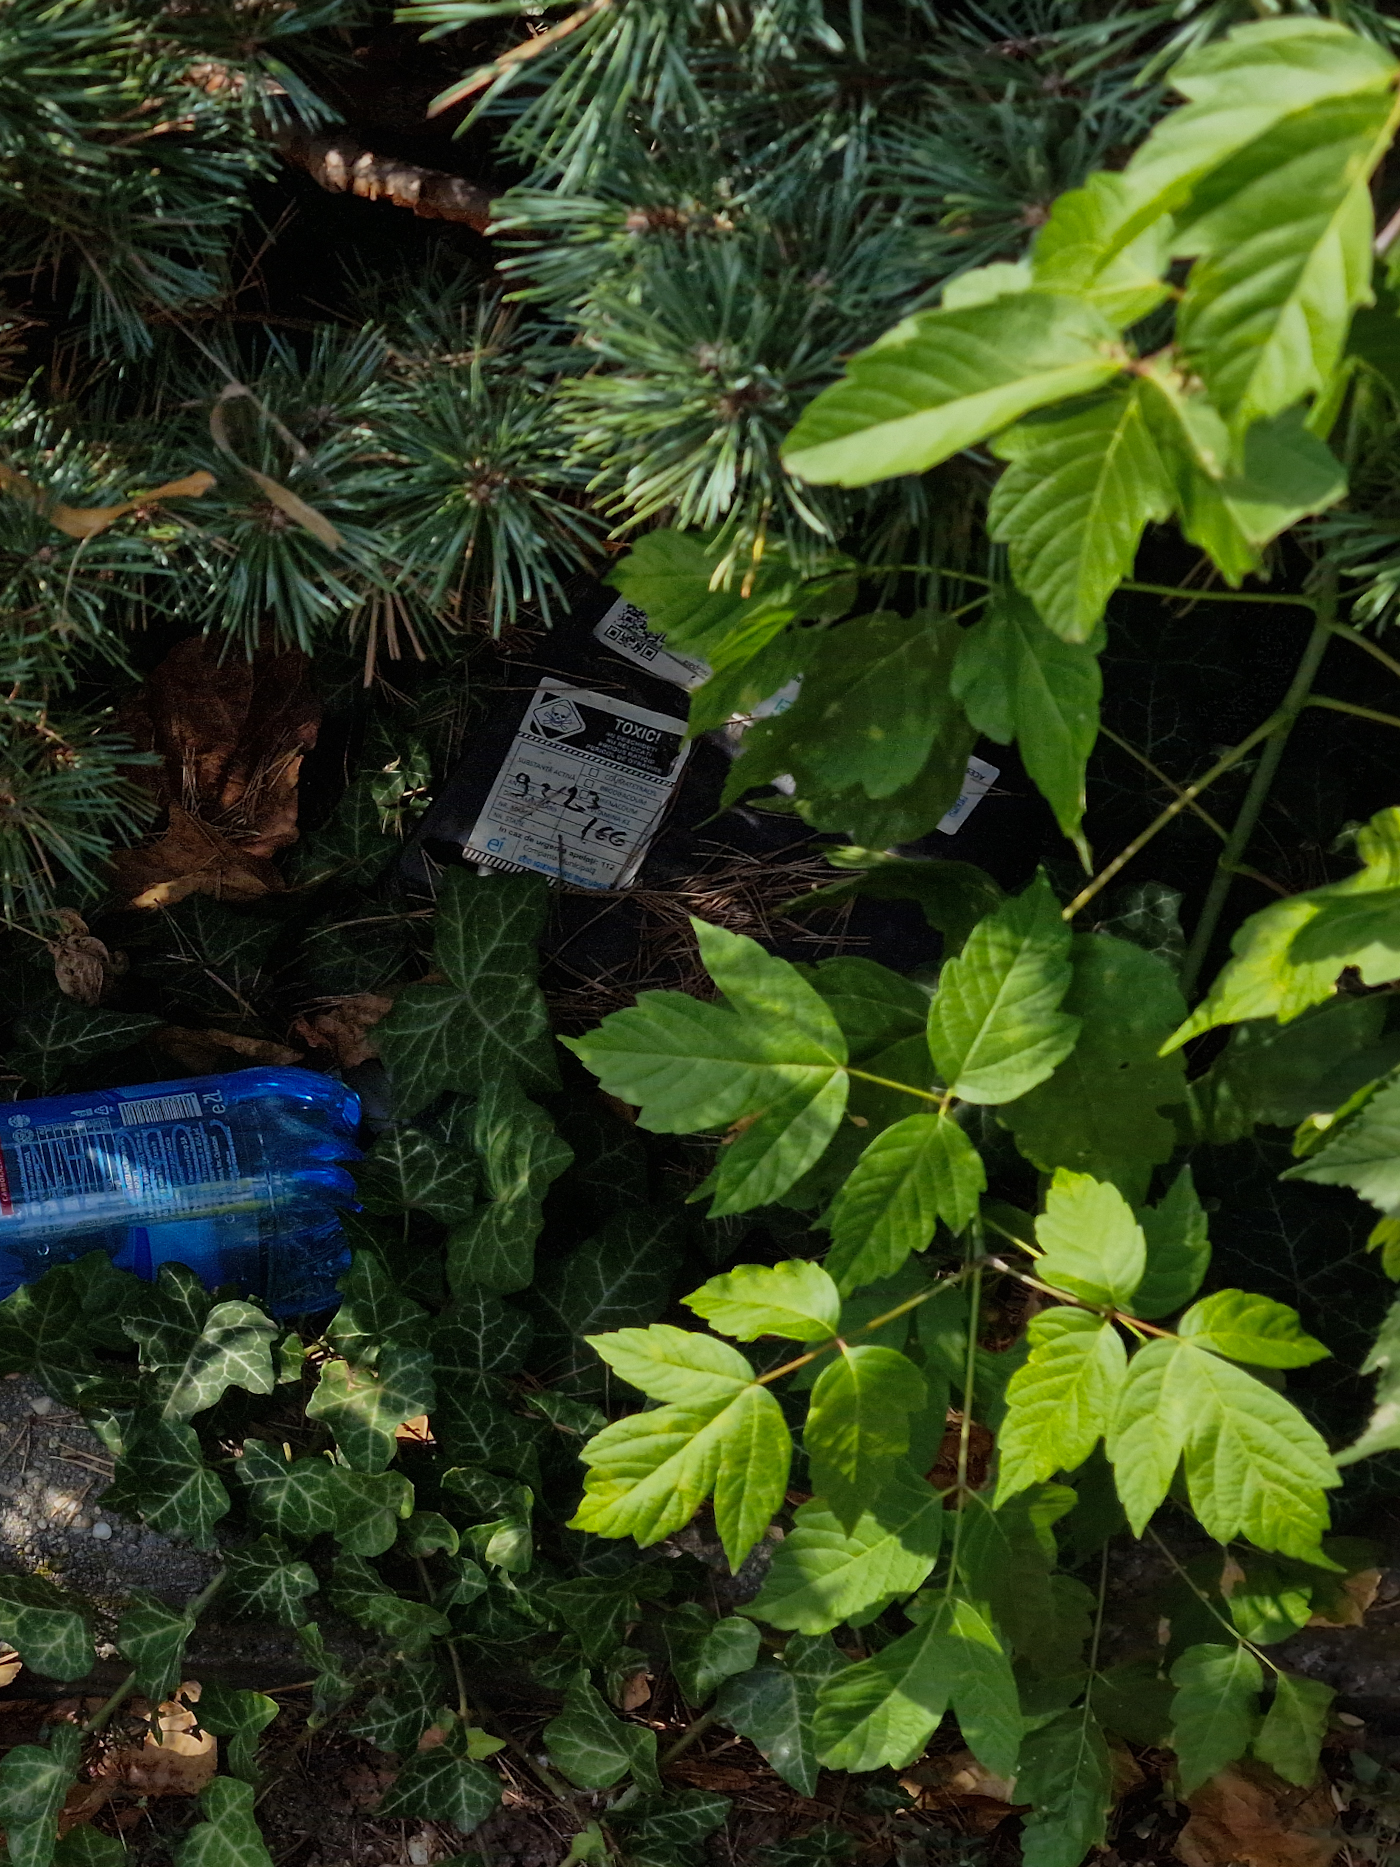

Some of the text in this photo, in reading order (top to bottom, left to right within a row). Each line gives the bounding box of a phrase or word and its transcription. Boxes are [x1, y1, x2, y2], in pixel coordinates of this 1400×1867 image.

[615, 718, 661, 744] TOXIC!
[508, 830, 522, 839] caz
[524, 835, 534, 843] de
[601, 862, 615, 870] 112
